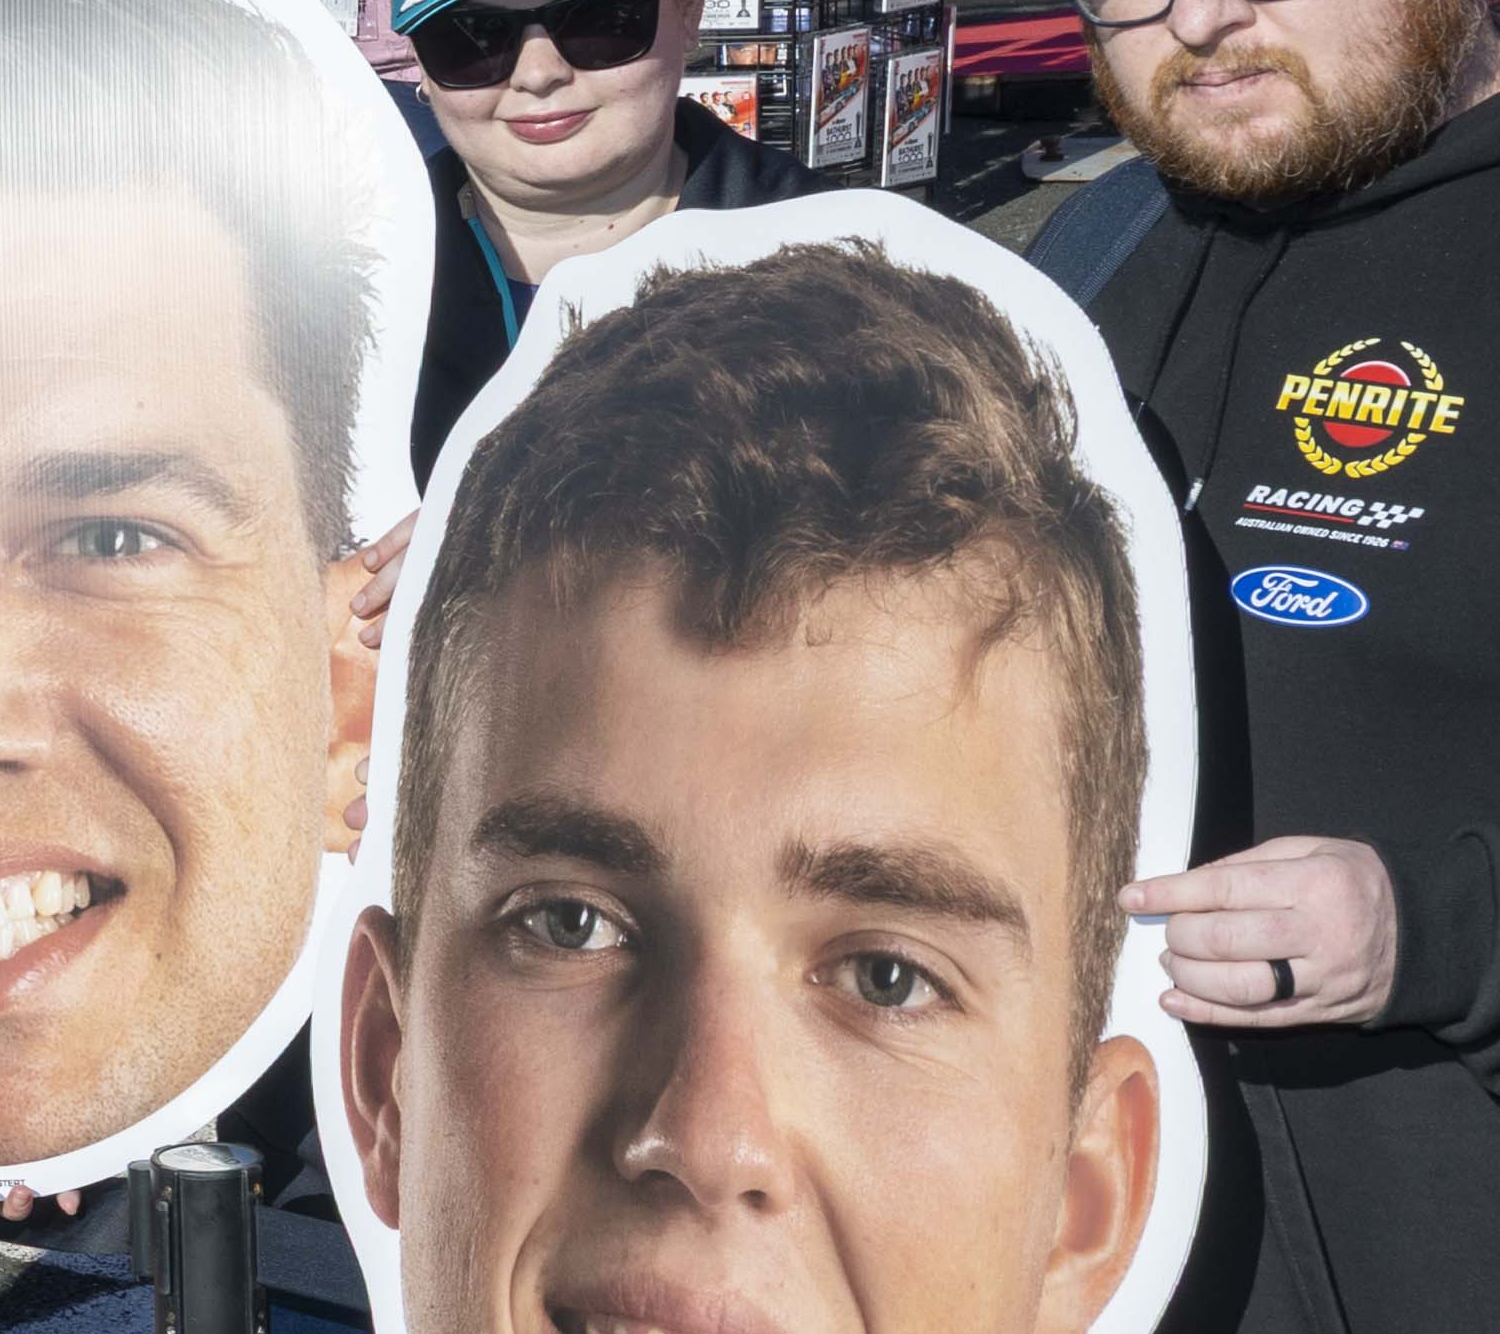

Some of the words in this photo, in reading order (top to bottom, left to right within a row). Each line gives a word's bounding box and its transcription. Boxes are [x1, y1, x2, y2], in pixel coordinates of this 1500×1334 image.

[1275, 373, 1465, 434] PENRITE
[1246, 485, 1365, 516] RACING
[1235, 517, 1294, 533] AUSTRALIAN
[1293, 524, 1330, 539] OWNED
[1329, 530, 1362, 544] SINCE
[1362, 535, 1390, 548] 1926
[1250, 572, 1339, 618] Ford
